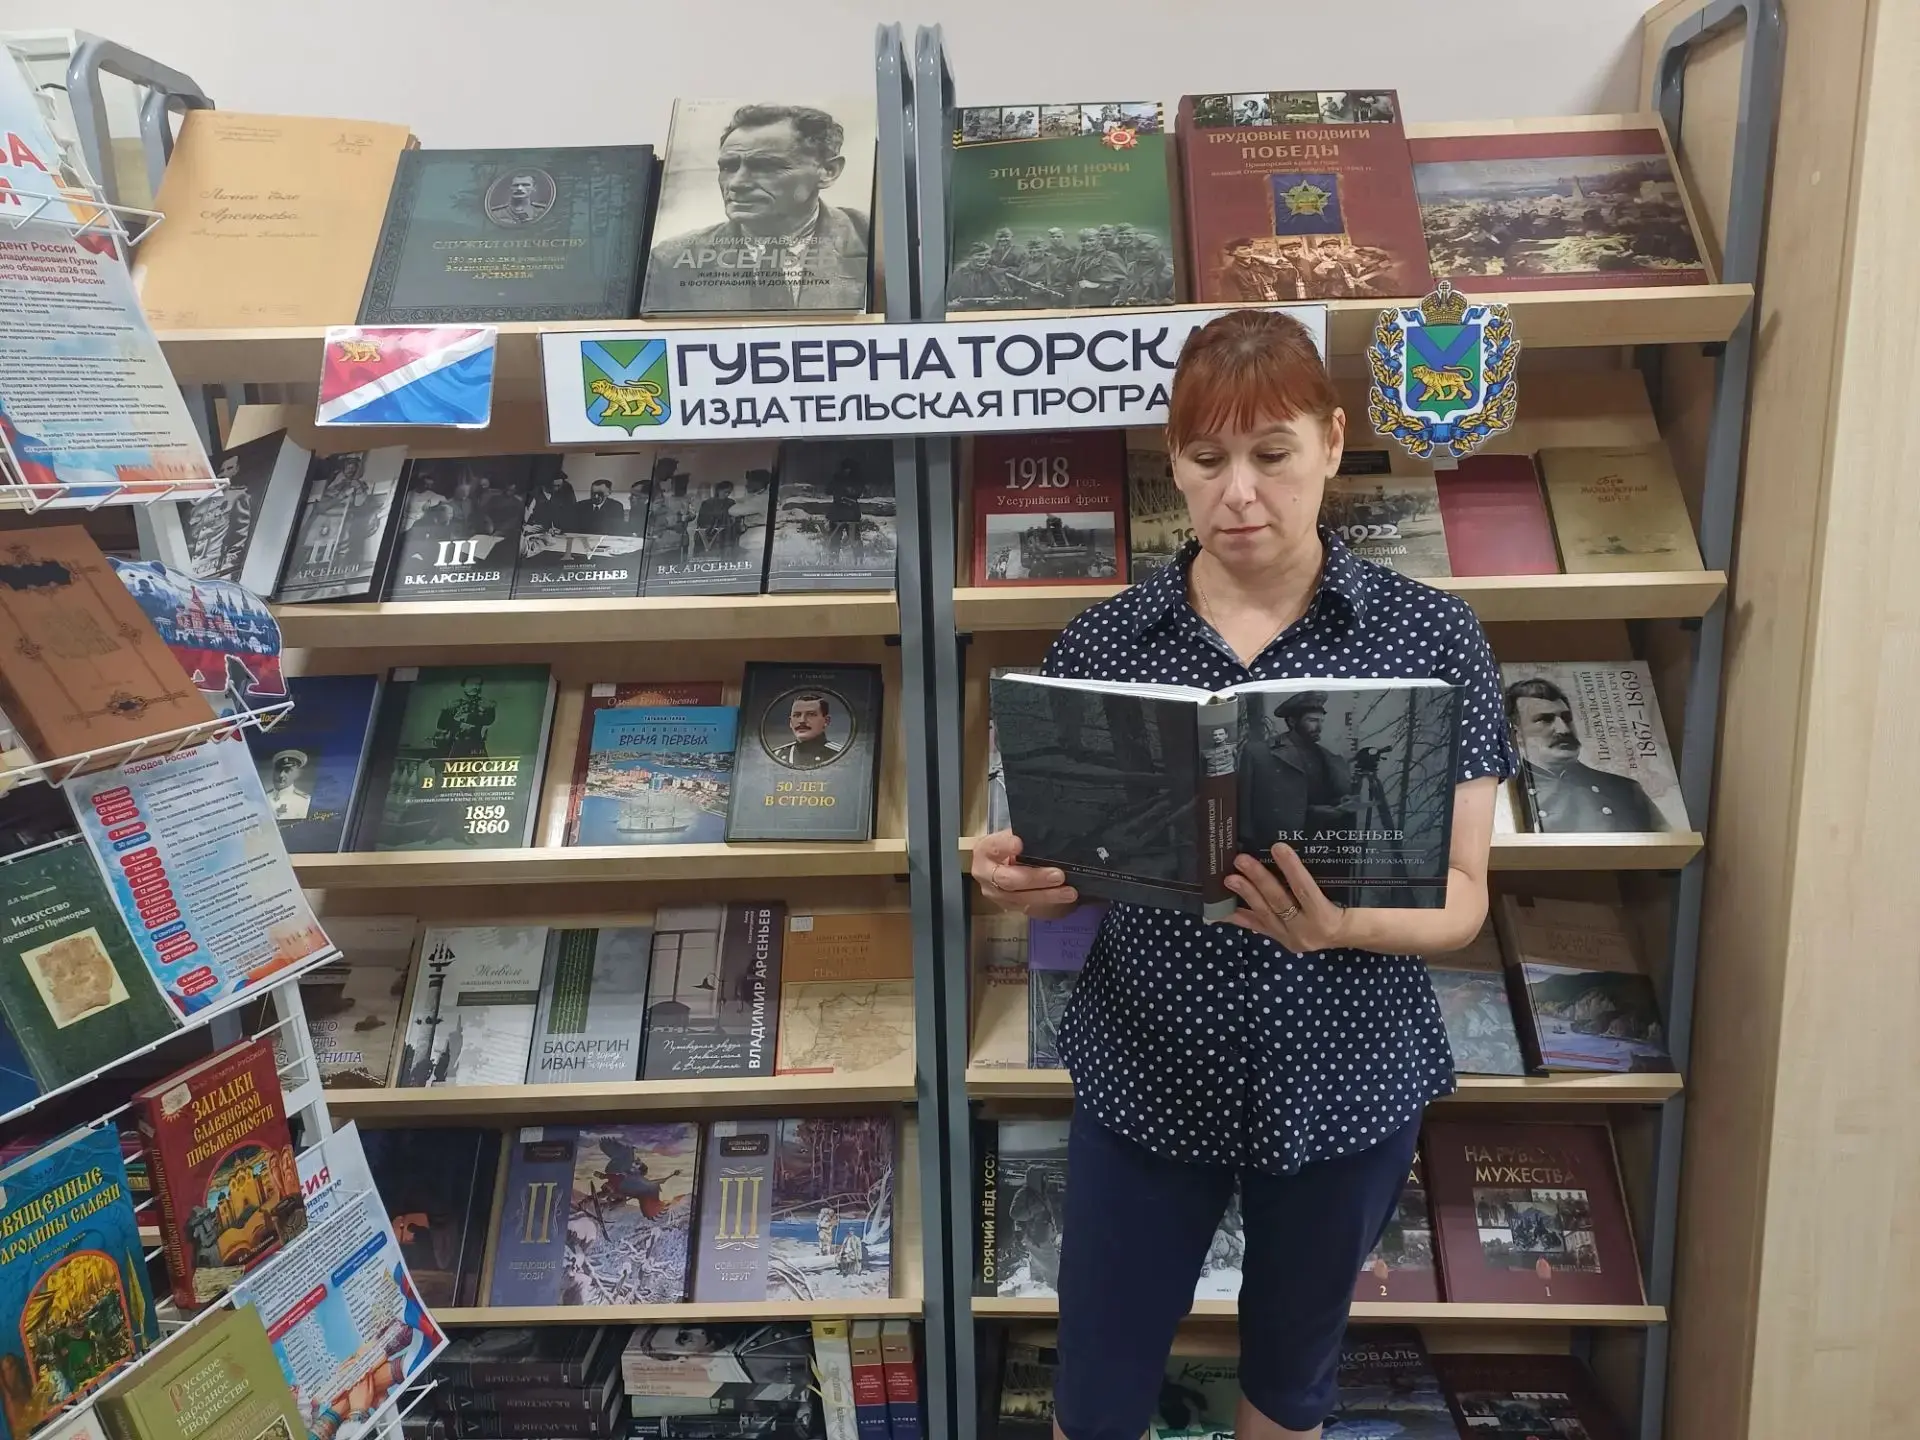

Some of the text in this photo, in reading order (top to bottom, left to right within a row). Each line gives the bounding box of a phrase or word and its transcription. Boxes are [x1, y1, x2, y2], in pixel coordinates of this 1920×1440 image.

[1208, 129, 1371, 144] ТРУДОВЫЕ ПОДВИГИ
[1241, 144, 1339, 160] ПОБЕДЫ
[988, 162, 1131, 179] ЭТИ ДНИ И НОЧИ
[31, 241, 77, 254] России
[502, 238, 588, 249] ОТЕЧЕСТВУ
[69, 256, 98, 266] Путин
[673, 249, 838, 269] АРСЕНЬЕВ
[17, 263, 97, 276] объявил 2026 год
[741, 270, 815, 278] ДЕЯТЕЛЬНОСТЬ
[30, 275, 106, 286] народов России
[679, 279, 686, 287] В
[687, 279, 757, 287] ФОТОГРАФИЯХ
[767, 279, 831, 287] ДОКУМЕНТАХ
[681, 383, 1170, 428] ИЗДАТЕЛЬСКАЯ ПРОГРА
[1004, 456, 1070, 491] 1918
[996, 494, 1109, 507] Уссурийский фронт
[694, 527, 725, 552] V
[1336, 524, 1402, 544] 1922
[306, 541, 336, 564] II
[433, 539, 479, 567] III
[561, 535, 608, 561] IV
[530, 569, 629, 583] В.К. АРСЕНЬЕВ
[656, 561, 753, 575] В.К. АРСЕНЬЕВ
[404, 571, 501, 585] В.К. АРСЕНЬЕВ
[1598, 672, 1618, 737] ПУТЕШЕСТВИЕ
[1580, 671, 1611, 760] ПРЖЕВАЛЬСКИЙ
[619, 734, 709, 746] ВРЕМЯ ПЕРВЫХ
[124, 749, 198, 777] народов России
[443, 760, 520, 773] МИССИЯ
[421, 775, 518, 789] В ПЕКИНЕ
[776, 781, 828, 792] 50 ЛЕТ
[765, 795, 836, 807] В СТРОЮ
[464, 805, 506, 820] 1859
[463, 819, 510, 834] -1860
[1277, 829, 1404, 841] В.К. АРСЕНЬЕВ
[1375, 857, 1425, 865] УКАЗАТЕЛЬ
[10, 901, 70, 927] Искусство
[2, 907, 91, 944] древнего Приморья
[748, 908, 771, 1070] ВЛАДИМИР АРСЕНЬЕВ
[543, 1038, 630, 1054] БАСАРГИН
[540, 1057, 586, 1070] ИВАН
[191, 1071, 255, 1124] ЗАГАДКИ
[193, 1090, 262, 1143] СЛАВЯНСКОЙ
[186, 1103, 274, 1169] ПИСЬМЕННОСТИ
[1464, 1145, 1493, 1163] НА
[1475, 1165, 1576, 1184] МУЖЕСТВА
[0, 1166, 103, 1240] ВЯЩЕННЫЕ
[70, 1183, 121, 1224] СЛАВЯН
[714, 1176, 764, 1240] III
[981, 1189, 997, 1217] ЛЁД
[520, 1182, 558, 1244] II
[981, 1220, 995, 1284] ГОРЯЧИЙ
[1379, 1285, 1388, 1297] 2
[1544, 1285, 1552, 1297] 1
[1341, 1350, 1420, 1362] КОВАЛЬ
[168, 1358, 222, 1413] Русское
[188, 1369, 225, 1406] устное
[176, 1379, 230, 1427] народное
